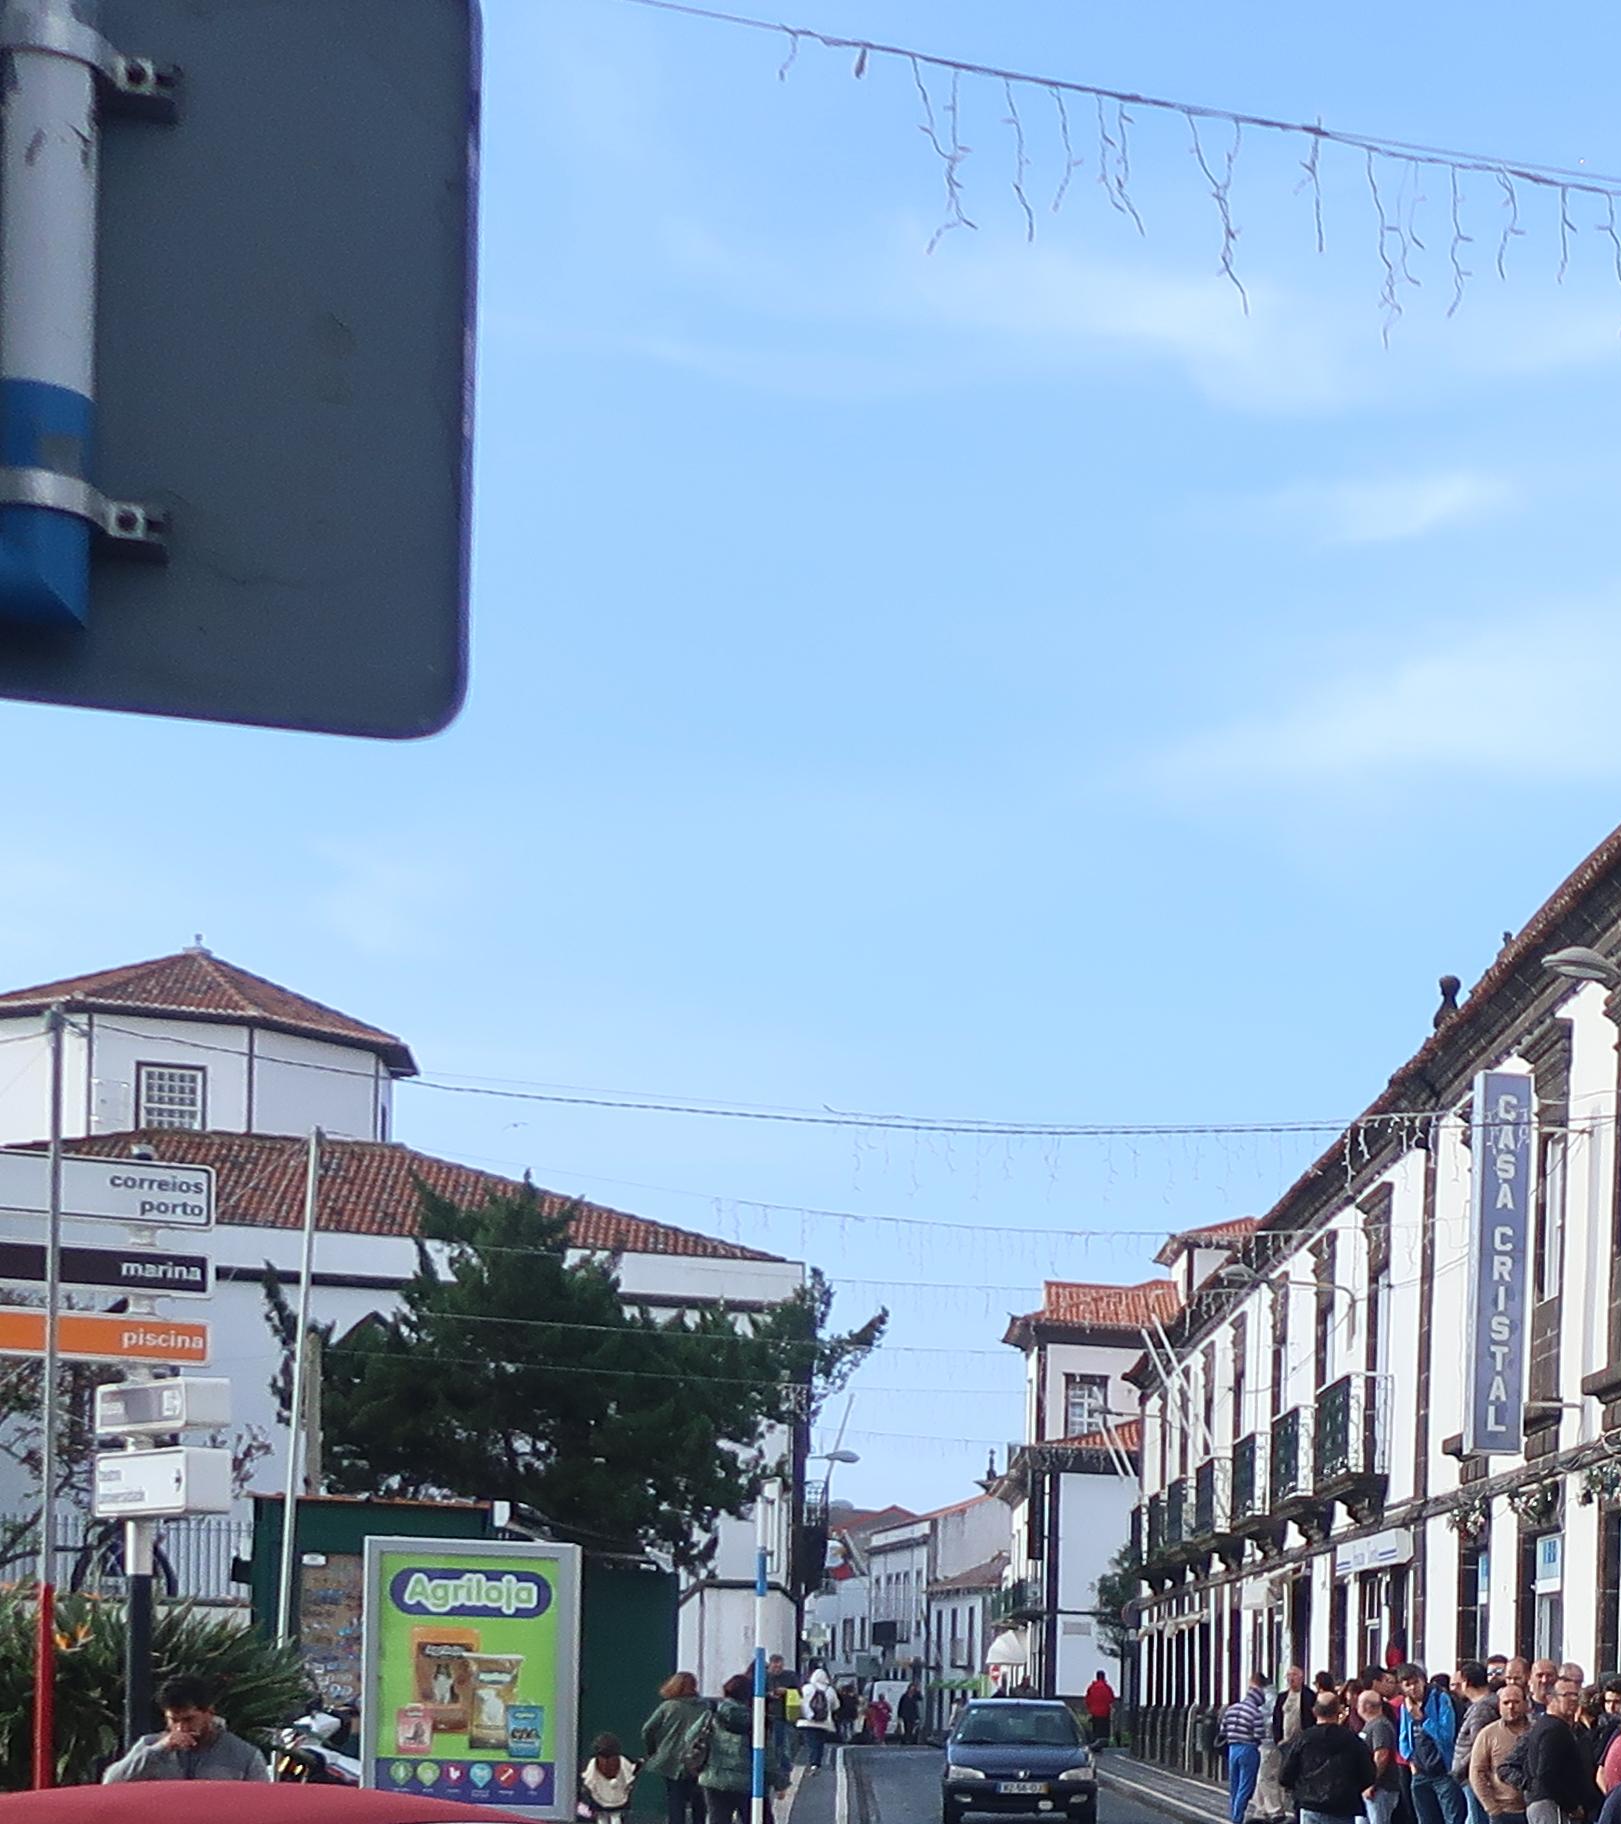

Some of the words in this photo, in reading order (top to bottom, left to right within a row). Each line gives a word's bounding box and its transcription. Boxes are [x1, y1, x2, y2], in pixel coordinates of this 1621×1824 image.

[1495, 1094, 1517, 1211] CASA
[109, 1174, 205, 1195] correios
[139, 1199, 204, 1217] porto
[120, 1261, 202, 1282] marina
[122, 1327, 205, 1350] piscina
[1486, 1226, 1514, 1433] CRISTAL
[404, 1572, 538, 1615] Agriloja
